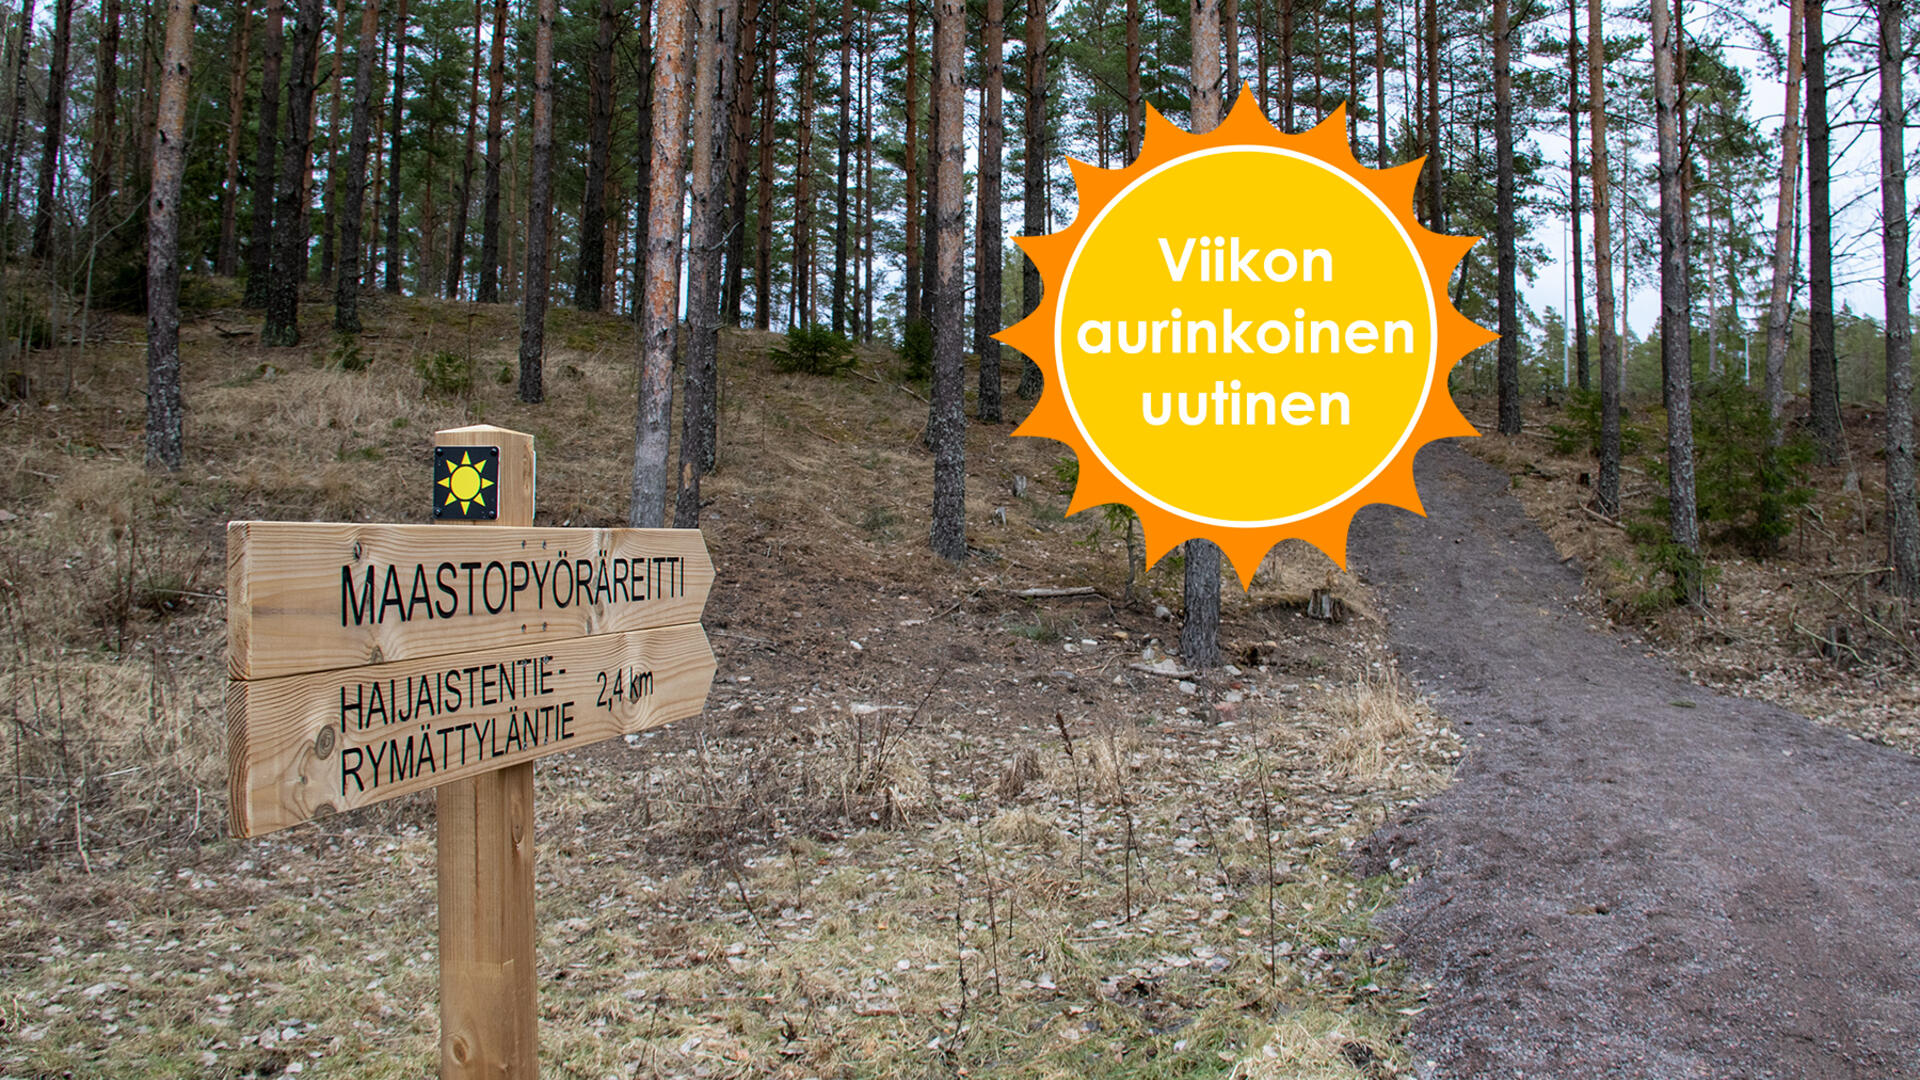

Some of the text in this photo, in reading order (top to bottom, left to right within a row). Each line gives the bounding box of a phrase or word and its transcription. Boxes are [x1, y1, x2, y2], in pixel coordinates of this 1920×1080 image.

[341, 551, 685, 627] MAASTOPYÖRÄREITTI
[340, 655, 566, 733] HAIJAISTENTIE-
[596, 666, 654, 711] 2,4 km
[341, 701, 575, 796] RYMÄTTYLÄNTIE
